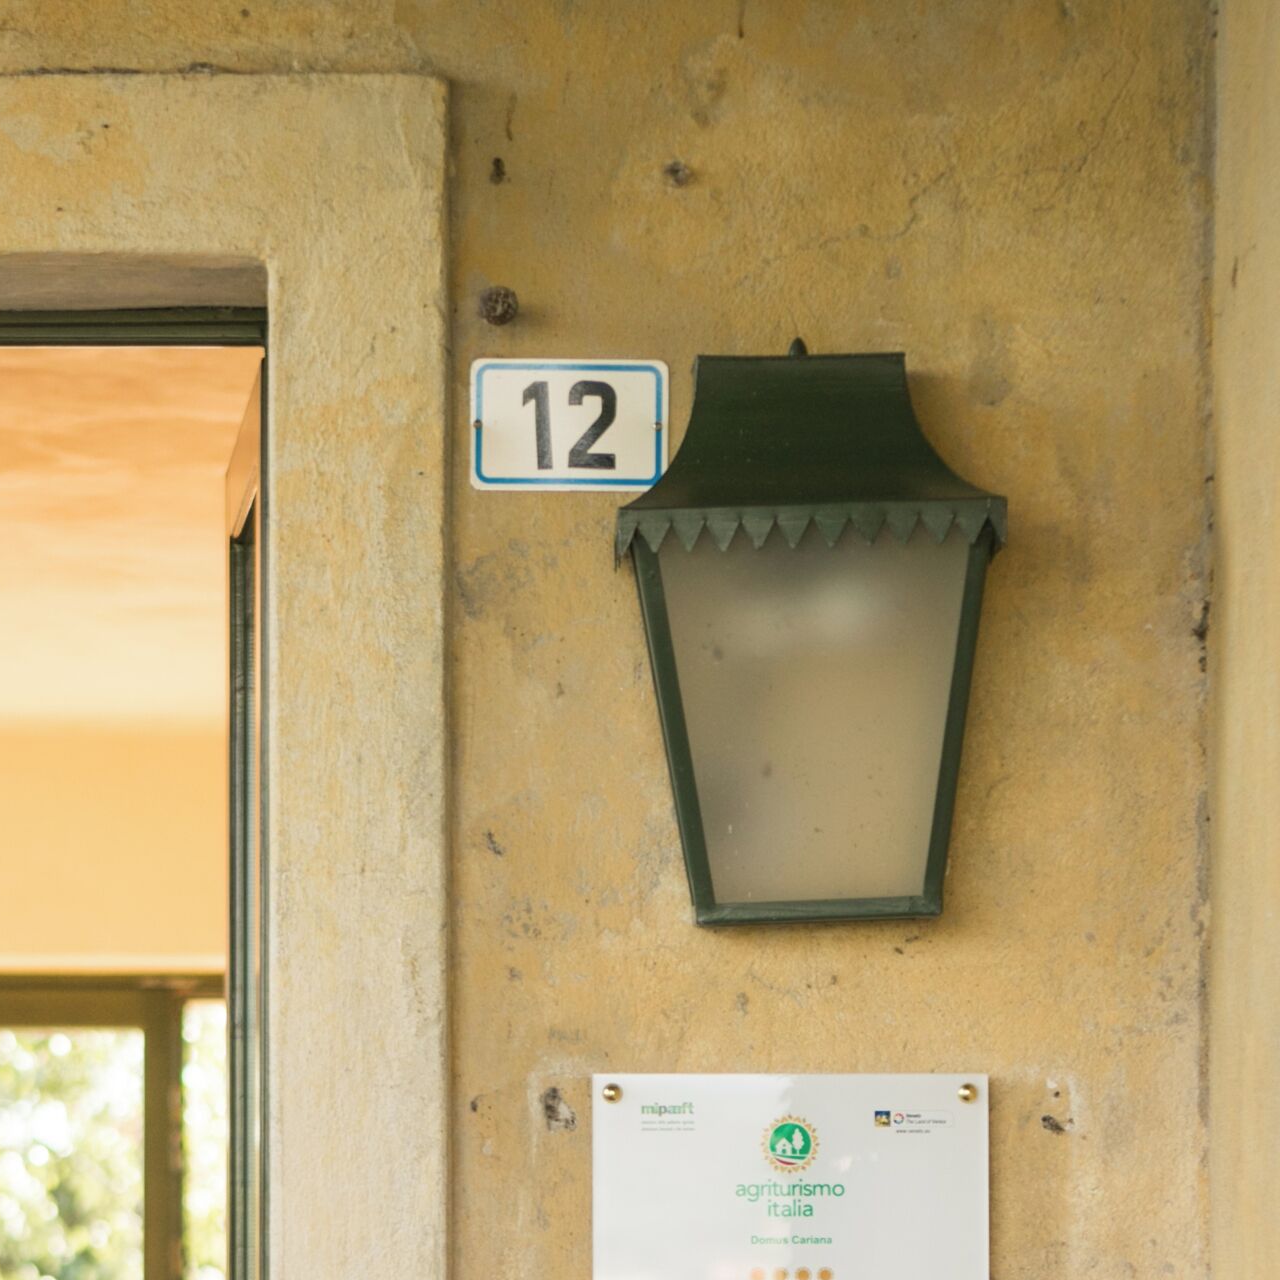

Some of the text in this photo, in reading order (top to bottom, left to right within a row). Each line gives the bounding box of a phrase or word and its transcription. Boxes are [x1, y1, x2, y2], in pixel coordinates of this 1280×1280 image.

[522, 380, 617, 470] 12
[735, 1178, 845, 1202] agriturismo
[767, 1199, 814, 1217] italia
[751, 1235, 833, 1244] Domus Cariana
